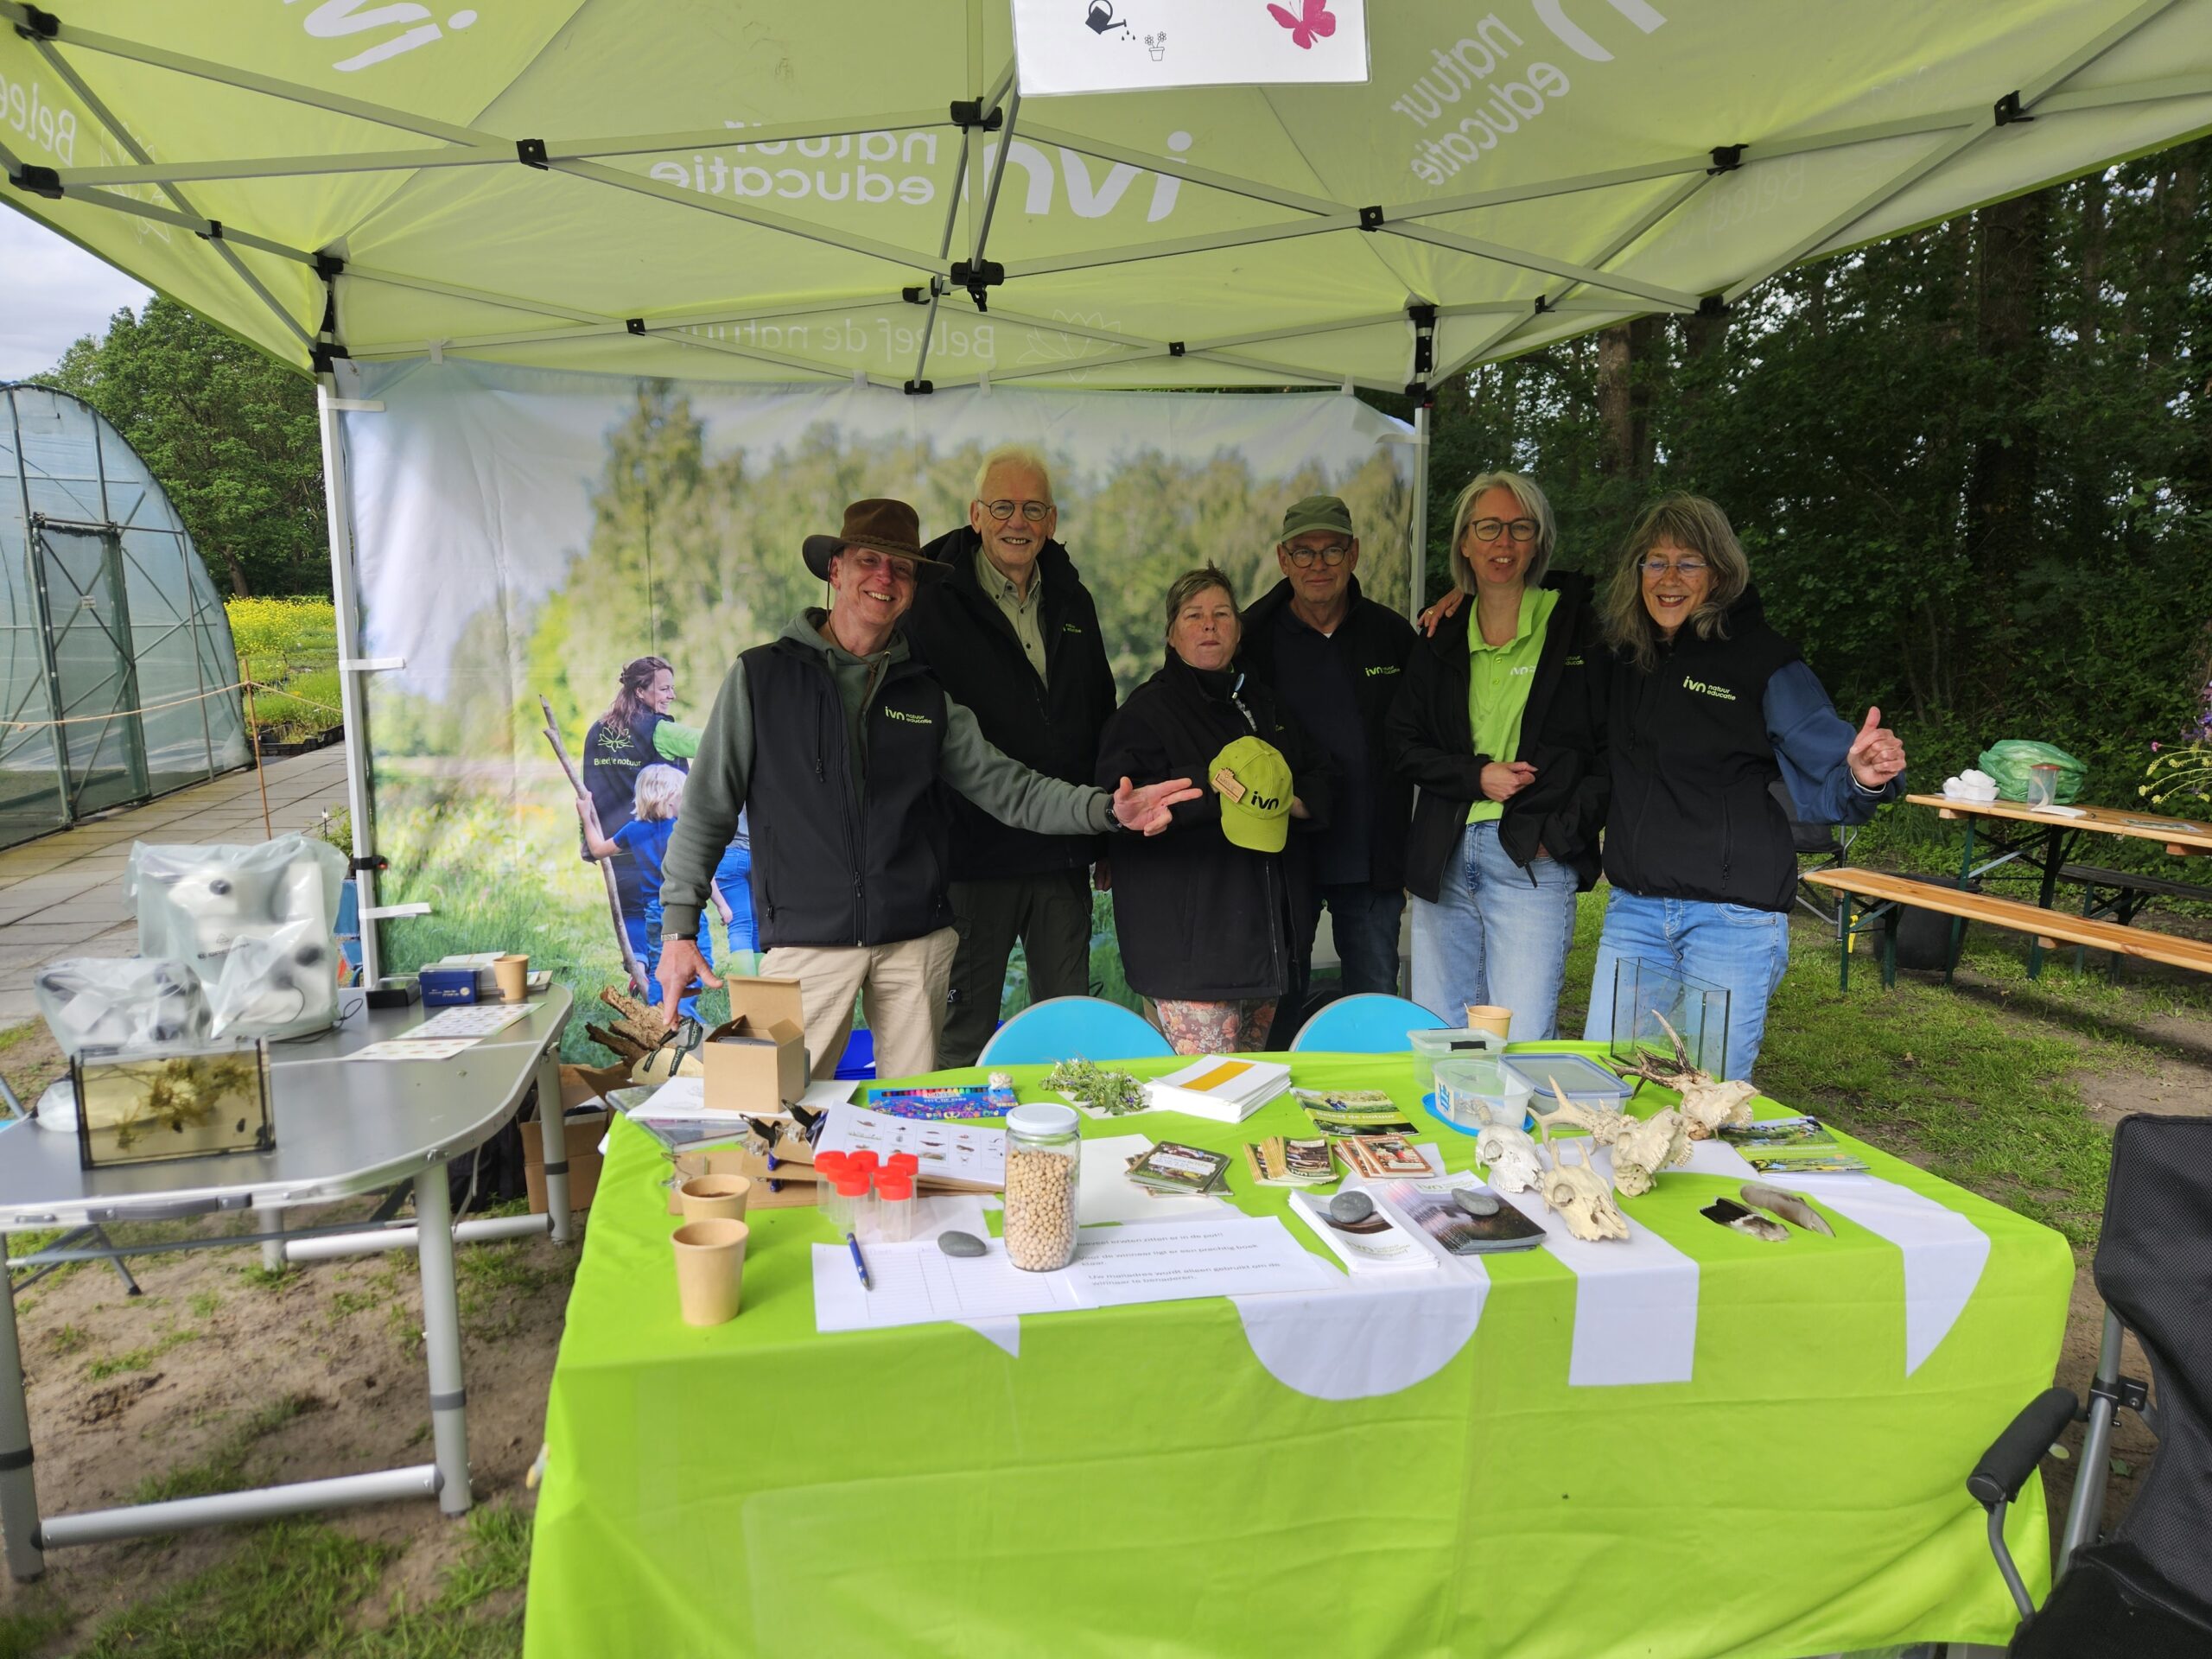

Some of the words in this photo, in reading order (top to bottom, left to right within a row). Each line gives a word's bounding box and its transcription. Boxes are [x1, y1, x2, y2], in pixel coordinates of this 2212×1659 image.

[1365, 667, 1383, 677] ivn
[1682, 675, 1707, 693] ivn
[1707, 684, 1731, 694] natuur
[1707, 690, 1737, 701] educatie
[885, 706, 906, 721] ivn
[1250, 791, 1280, 810] ivn
